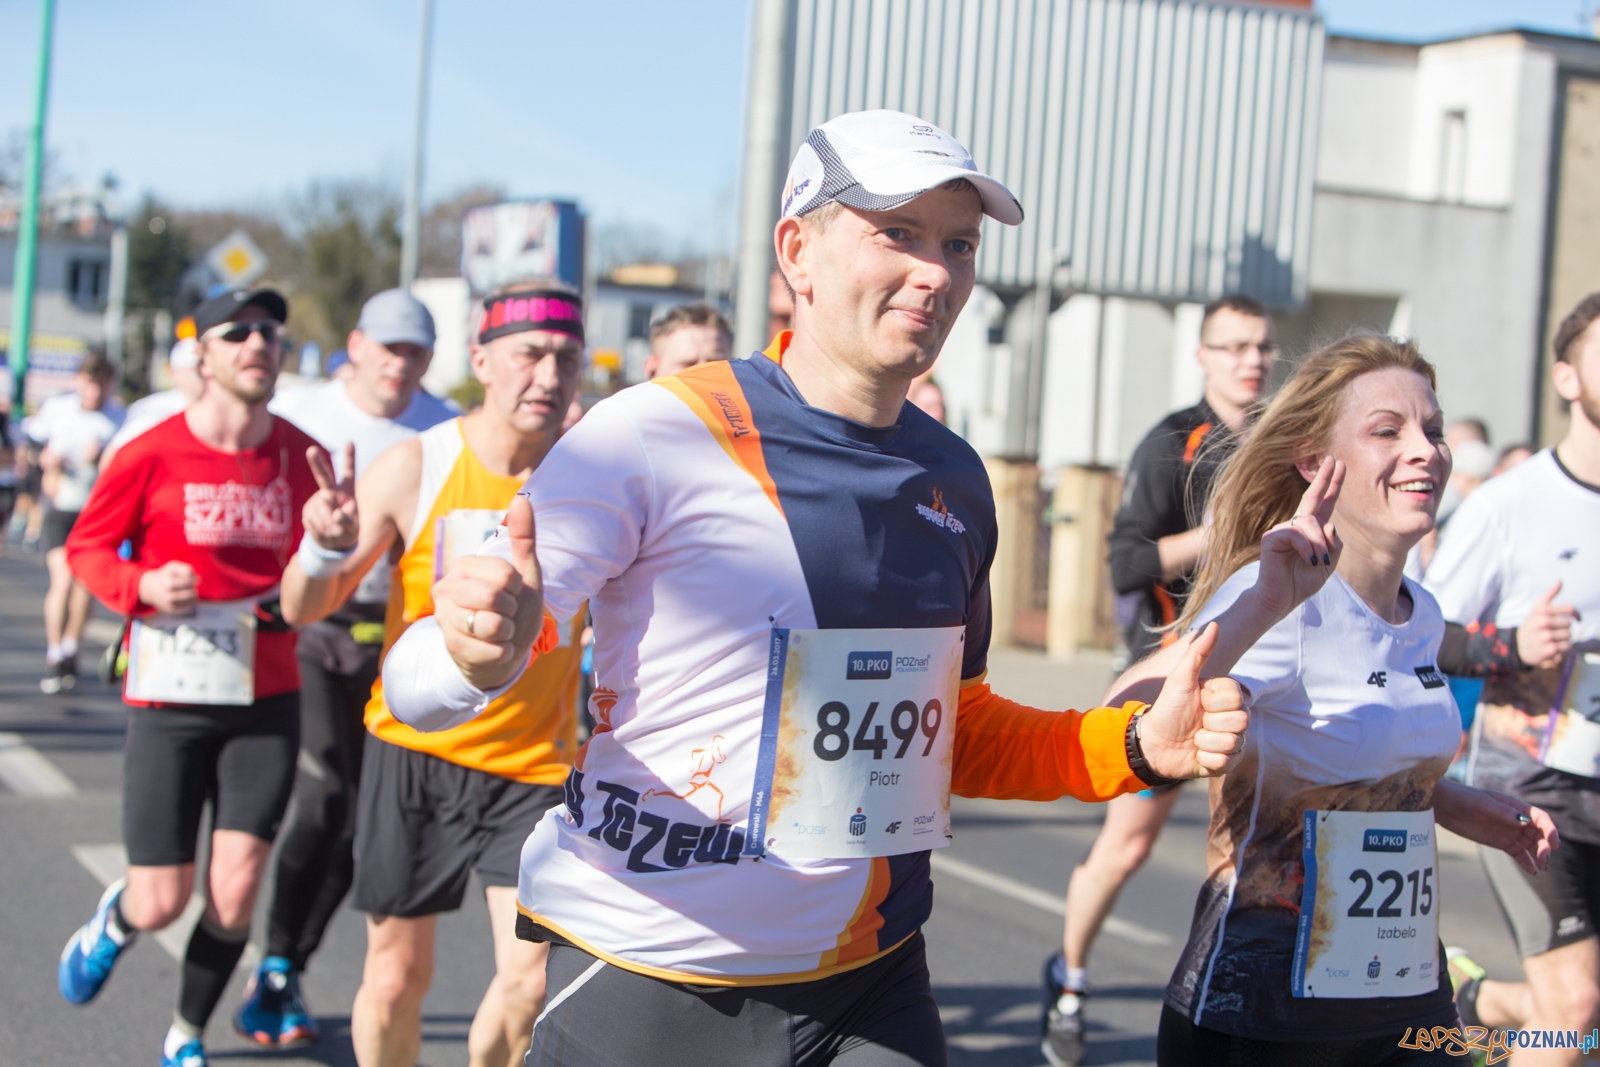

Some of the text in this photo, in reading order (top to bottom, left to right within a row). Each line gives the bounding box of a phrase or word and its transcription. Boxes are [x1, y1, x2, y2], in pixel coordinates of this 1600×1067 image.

[770, 637, 782, 676] 26.03.2017
[813, 698, 942, 762] 8499
[869, 771, 901, 787] Piotr
[750, 812, 761, 850] Ostrowski
[1347, 867, 1433, 918] 2215
[1377, 926, 1417, 939] Izabela
